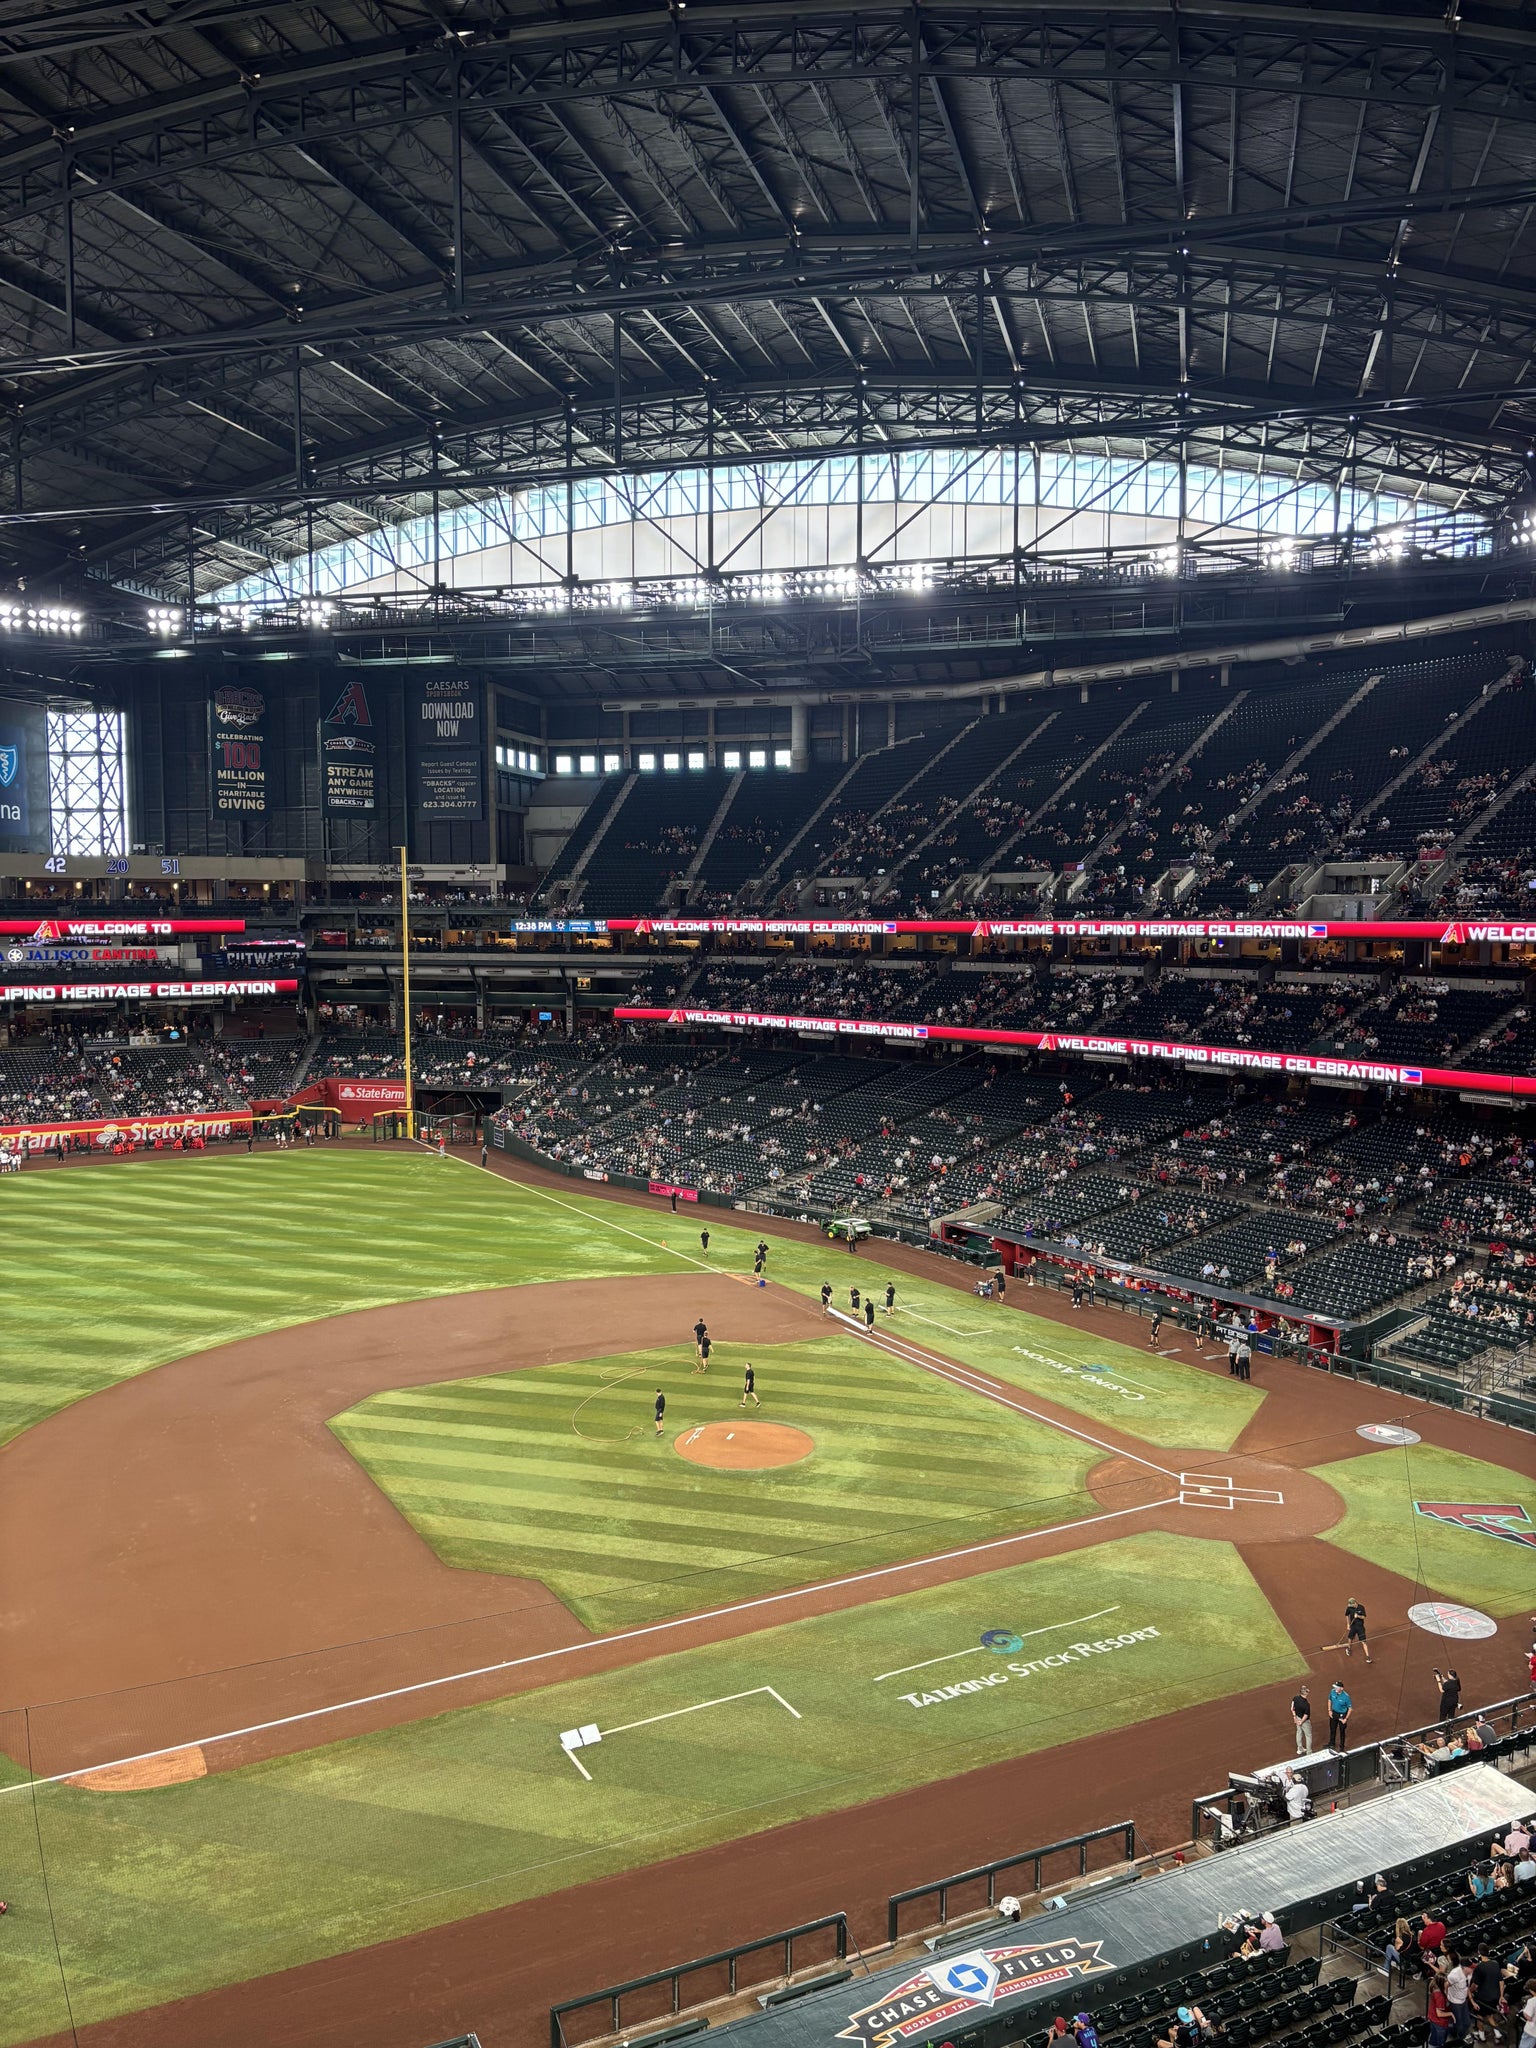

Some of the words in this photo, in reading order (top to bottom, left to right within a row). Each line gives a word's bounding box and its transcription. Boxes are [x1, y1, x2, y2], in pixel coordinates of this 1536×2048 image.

[426, 681, 469, 690] CAESARS
[422, 702, 474, 719] DOWNLOAD
[437, 720, 459, 737] NOW
[217, 733, 263, 741] CELEBRATING
[215, 742, 260, 769] $100
[217, 770, 265, 781] MILLION
[327, 766, 374, 778] STREAM
[328, 778, 347, 786] ANY
[349, 779, 374, 787] GAME
[218, 790, 265, 798] CHARITABLE
[328, 788, 374, 796] ANYWHERE
[218, 799, 266, 810] GIVING
[423, 800, 477, 808] 623.304.0777
[45, 858, 66, 872] 42
[106, 859, 129, 873] 20
[161, 859, 180, 874] 51
[68, 923, 147, 934] WELCOME
[152, 923, 171, 934] TO
[515, 922, 536, 930] 12:38
[538, 922, 552, 930] PM
[652, 922, 710, 931] WELCOME
[711, 922, 725, 931] TO
[727, 922, 763, 931] FILIPINO
[765, 923, 811, 932] HERITAGE
[813, 923, 882, 932] CELEBRATION
[990, 924, 1054, 935] WELCOME
[1058, 924, 1076, 935] TO
[1079, 924, 1136, 935] FILIPINO
[1140, 924, 1205, 936] HERITAGE
[1208, 924, 1306, 937] CELEBRATION
[26, 949, 89, 961] JALISCO
[93, 948, 158, 961] CANTINA
[62, 985, 151, 999] HERITAGE
[157, 982, 276, 997] CELEBRATION
[685, 1012, 732, 1024] WELCOME
[733, 1015, 745, 1024] TO
[748, 1016, 786, 1028] FILIPINO
[788, 1019, 836, 1031] HERITAGE
[839, 1023, 913, 1037] CELEBRATION
[1057, 1038, 1127, 1053] WELCOME
[1131, 1043, 1148, 1055] TO
[1152, 1045, 1207, 1061] FILIPINO
[1211, 1051, 1282, 1069] HERITAGE
[1286, 1058, 1398, 1081] CELEBRATION
[356, 1087, 379, 1099] State
[381, 1088, 404, 1099] Farm
[1216, 1325, 1227, 1334] PIT
[1011, 1345, 1082, 1374] ARIZONA
[1080, 1374, 1145, 1400] CASINO
[897, 1672, 1008, 1708] TALKING
[1007, 1651, 1080, 1677] STICK
[1068, 1626, 1162, 1657] RESORT
[867, 1989, 941, 2029] CHASE
[1003, 1948, 1076, 1975] FIELD
[905, 2016, 932, 2031] HOME
[935, 2009, 947, 2018] OF
[951, 2000, 970, 2011] THE
[999, 1970, 1065, 1994] DIAMONDBACKS
